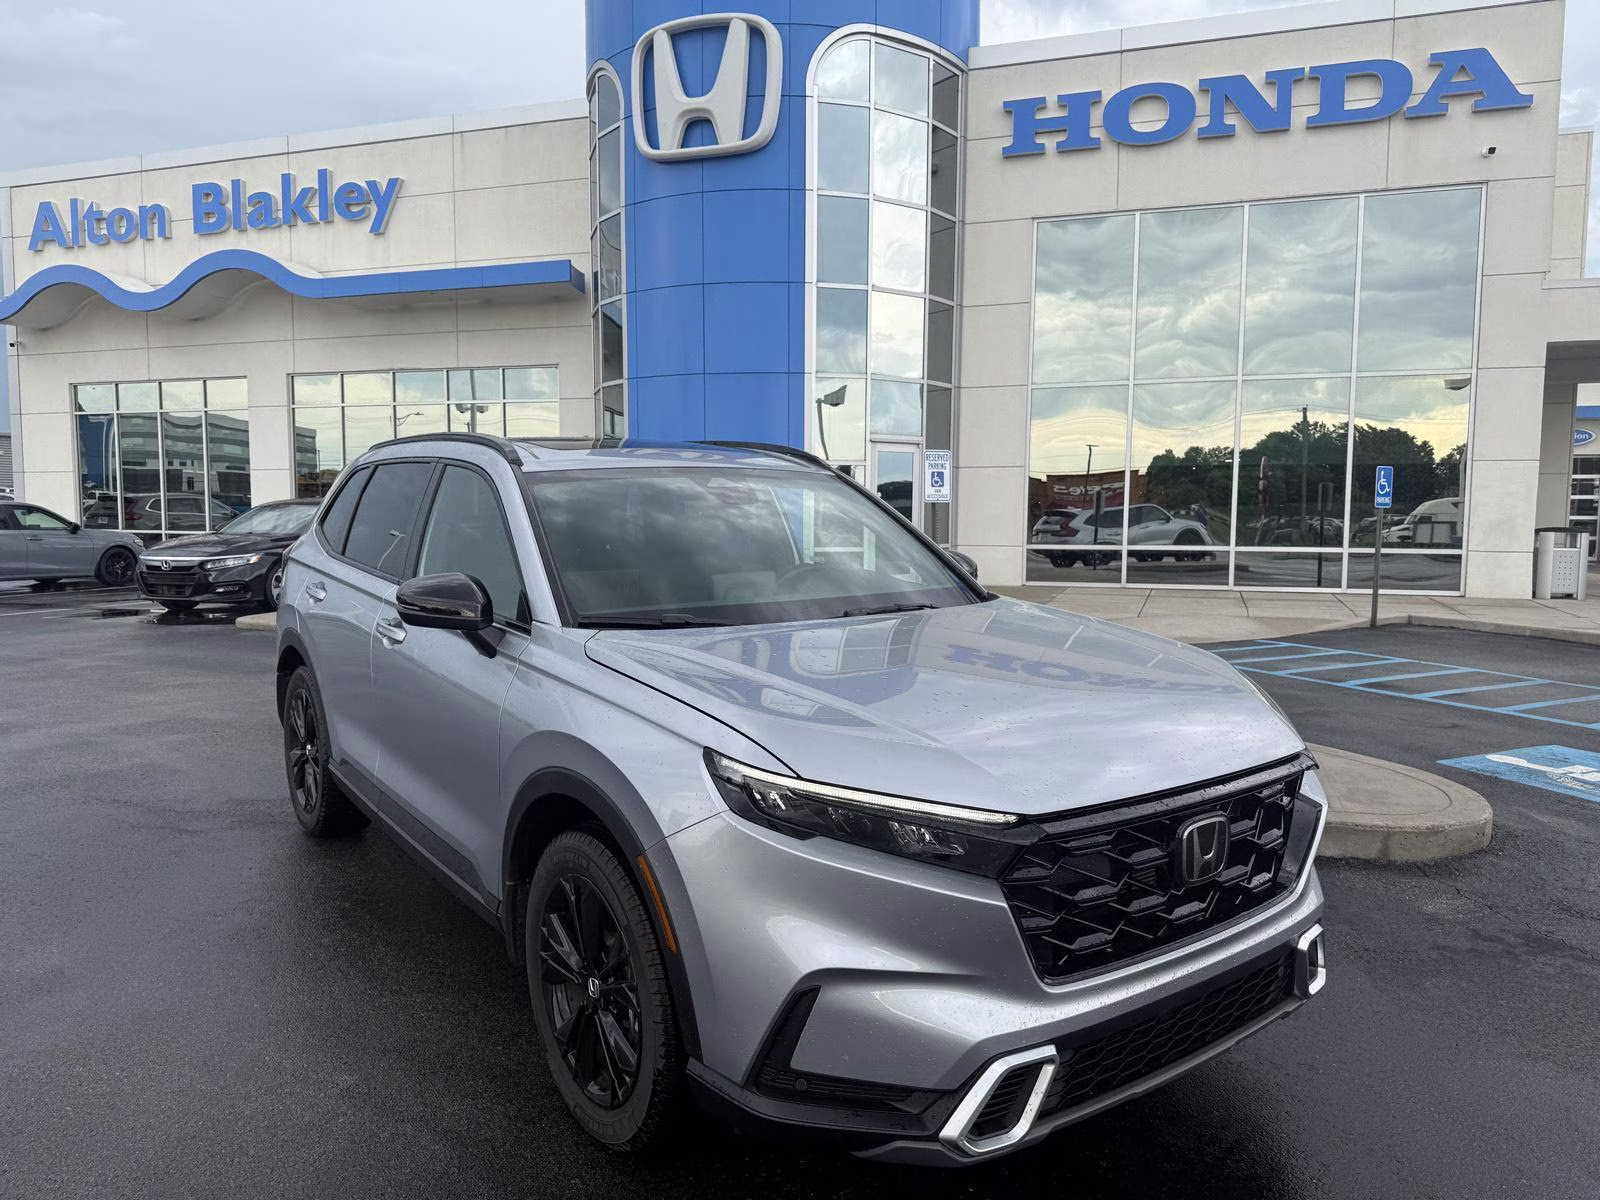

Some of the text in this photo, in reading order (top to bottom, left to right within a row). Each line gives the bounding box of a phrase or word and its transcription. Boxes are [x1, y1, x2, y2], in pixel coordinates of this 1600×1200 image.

[1001, 47, 1534, 158] HONDA
[28, 168, 405, 251] Alton Blakley
[926, 454, 948, 462] RESERVED
[928, 462, 947, 470] PARKING
